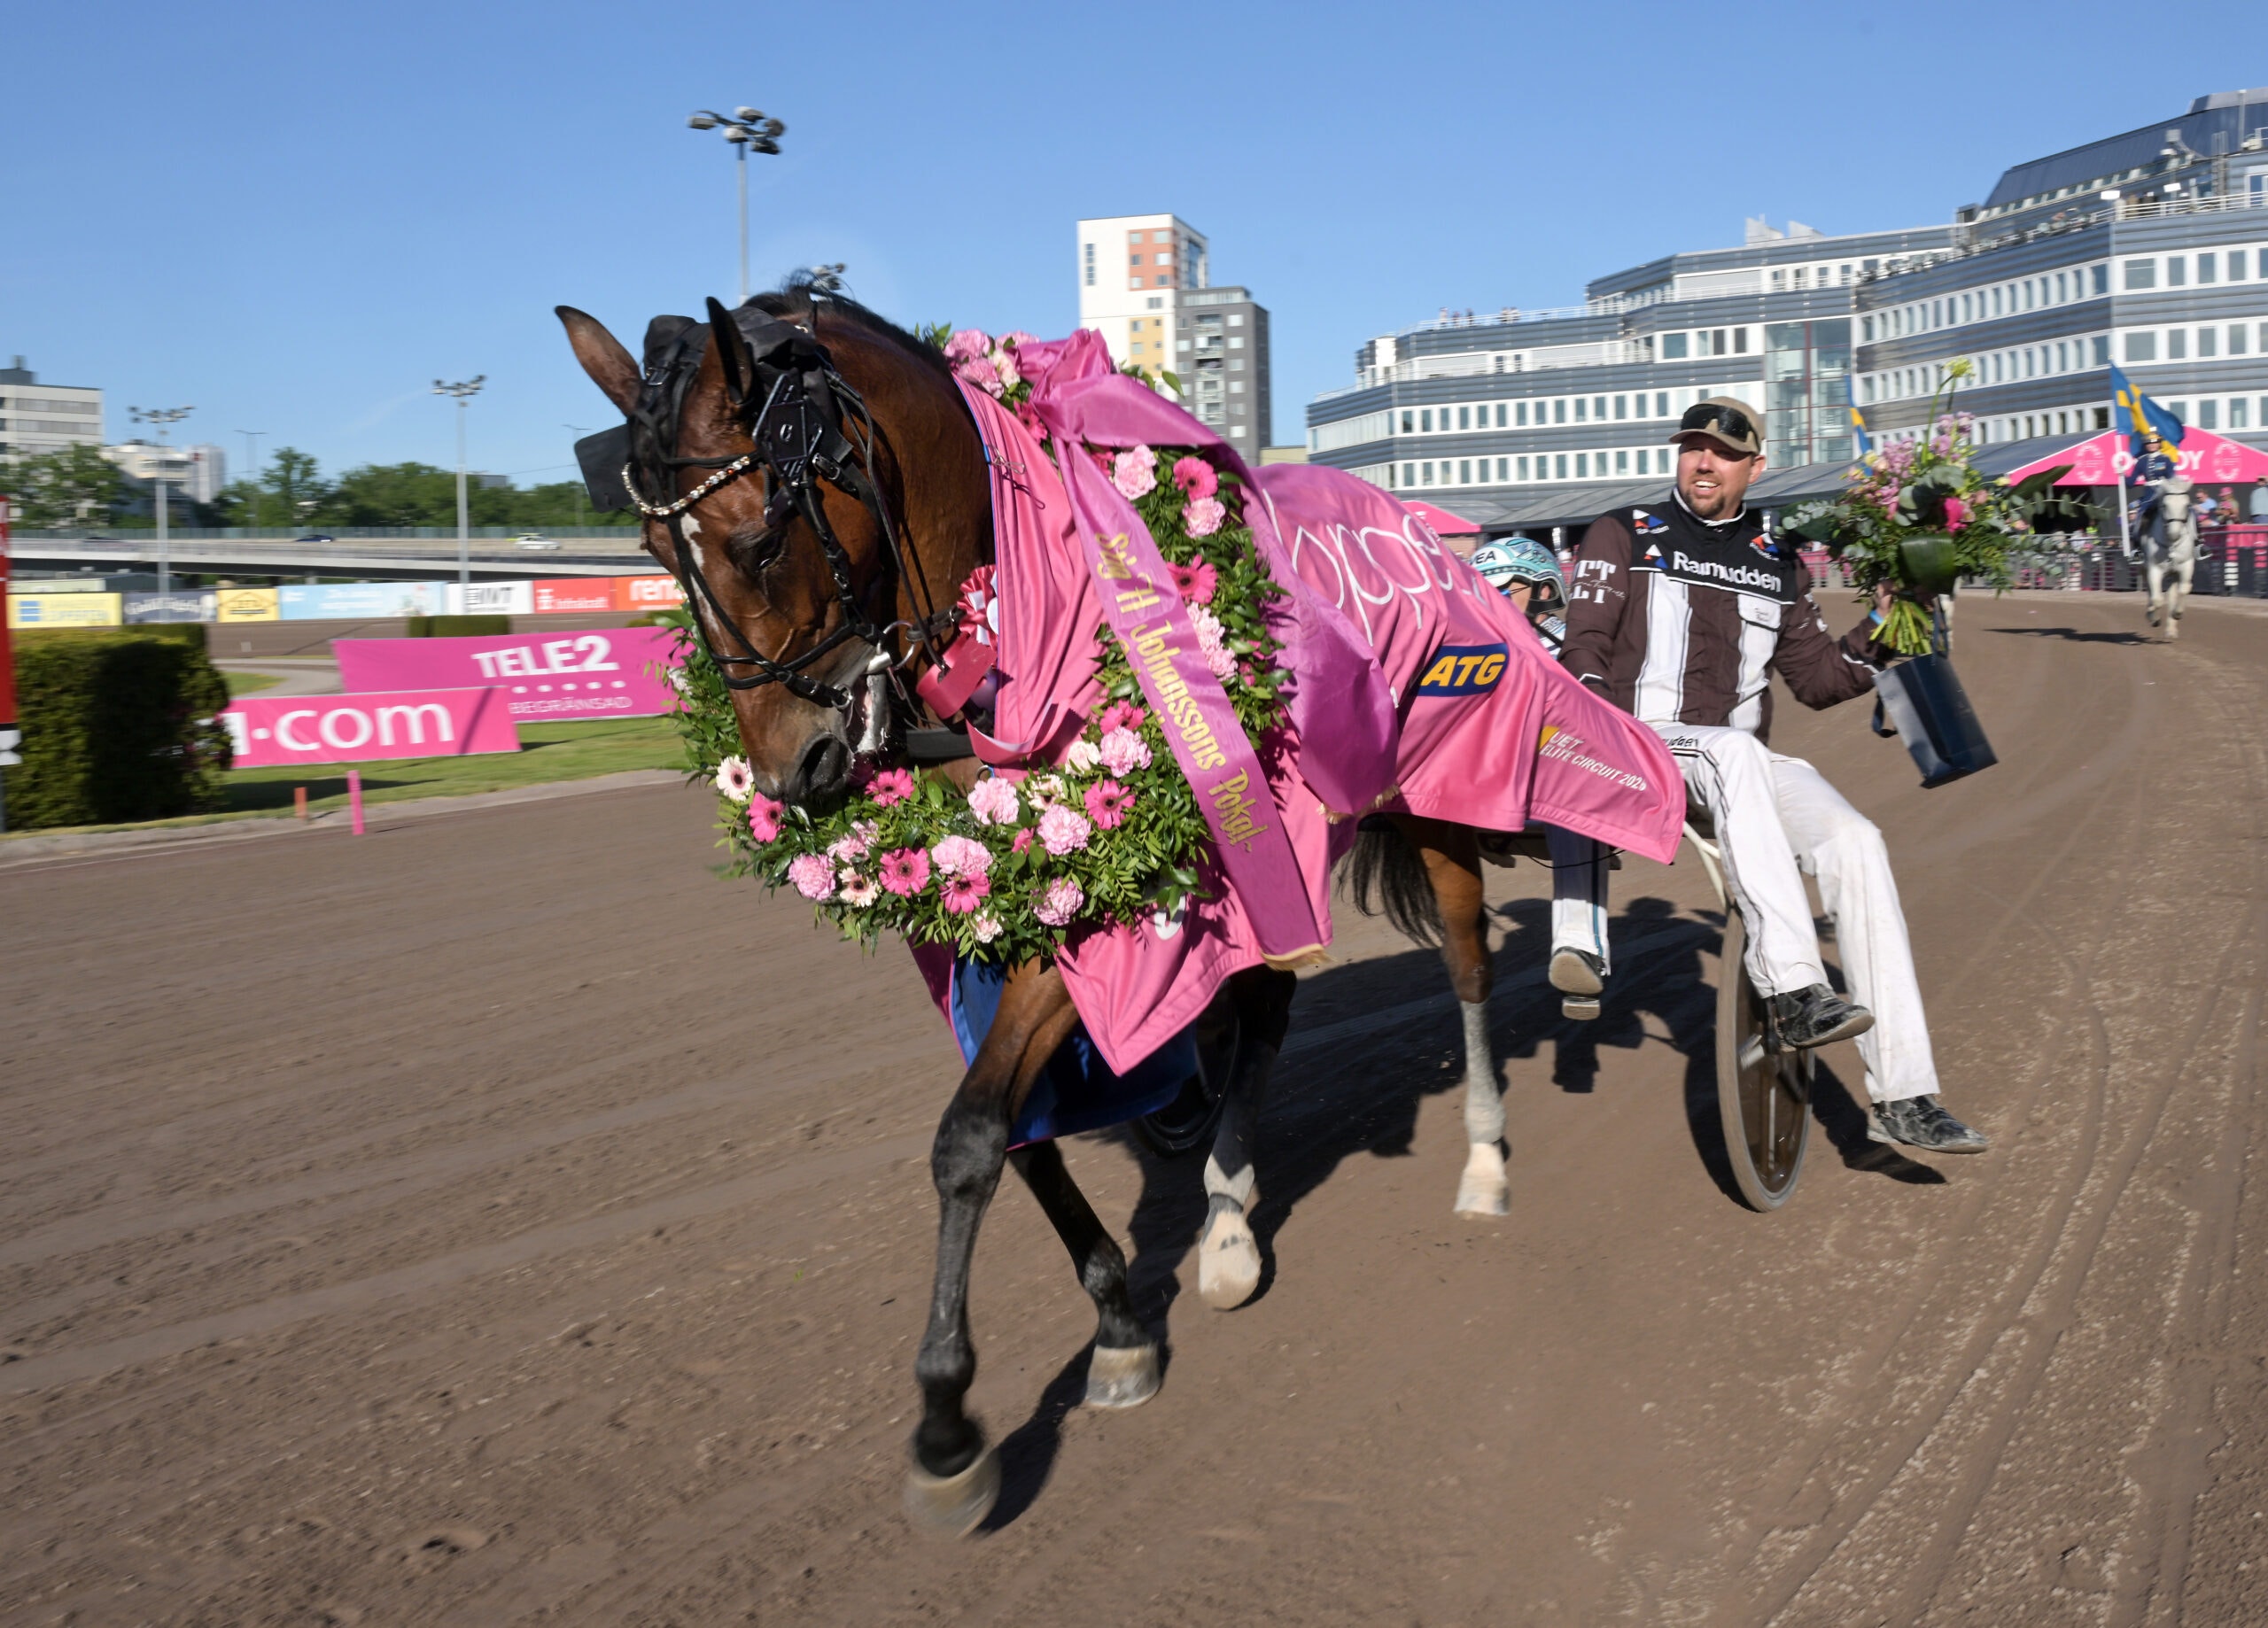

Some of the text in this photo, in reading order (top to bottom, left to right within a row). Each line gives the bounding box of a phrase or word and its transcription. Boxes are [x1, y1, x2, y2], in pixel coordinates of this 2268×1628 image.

[1673, 549, 1783, 593] Ramudden
[1115, 572, 1161, 615] H
[470, 635, 620, 678] TELE2
[1421, 653, 1507, 687] ATG
[1129, 620, 1227, 771] Johanssons
[1539, 744, 1575, 762] ELITE
[1571, 755, 1623, 780] CIRCUIT
